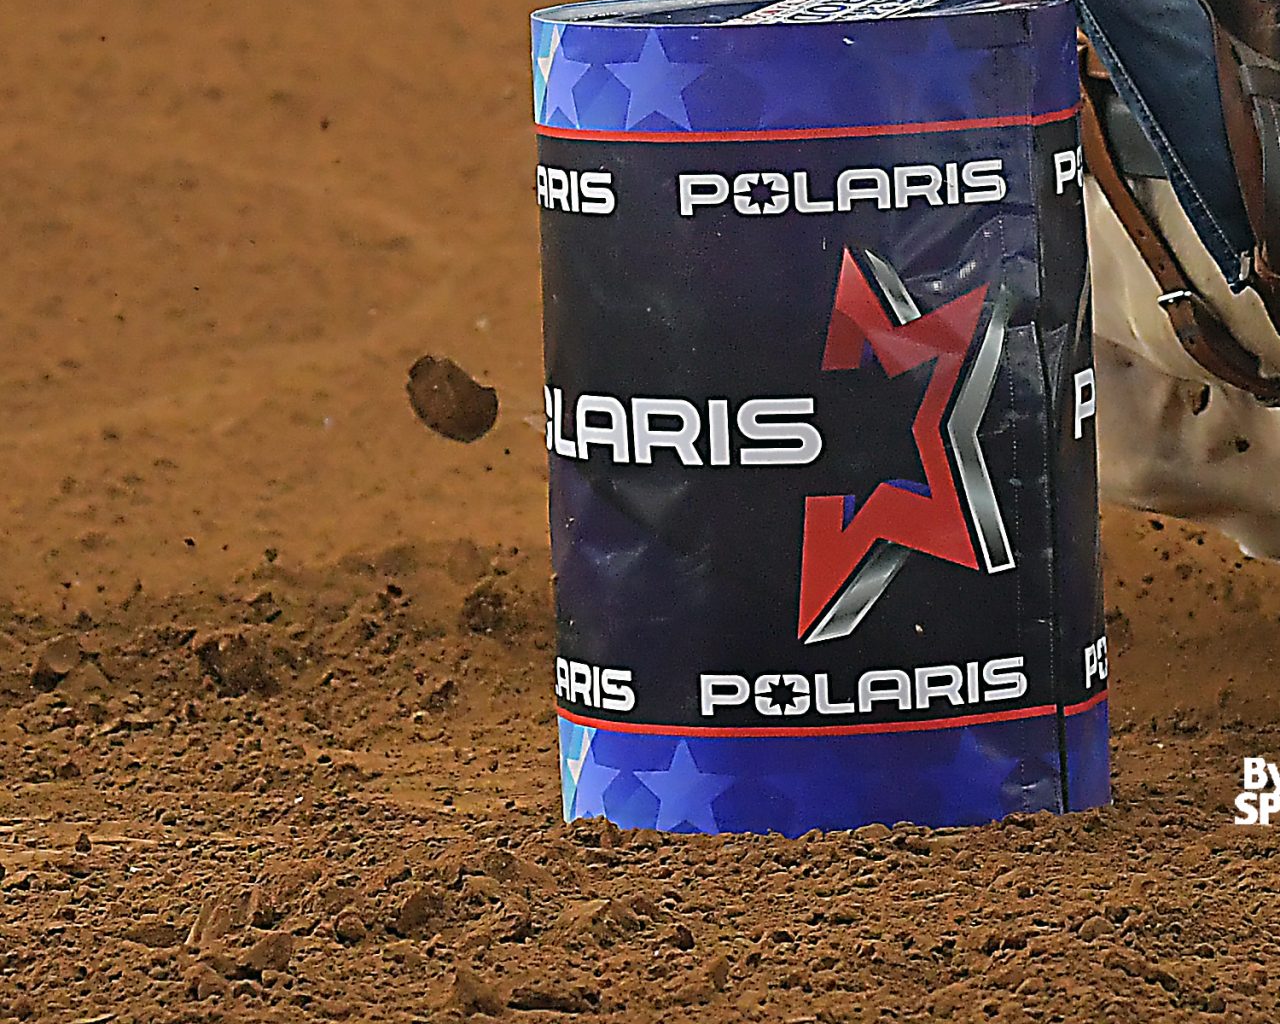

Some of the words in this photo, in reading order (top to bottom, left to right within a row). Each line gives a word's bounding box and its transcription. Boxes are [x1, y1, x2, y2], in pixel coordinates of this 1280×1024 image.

[679, 159, 1006, 215] POLARIS
[544, 384, 823, 466] LARIS
[701, 656, 1027, 716] POLARIS
